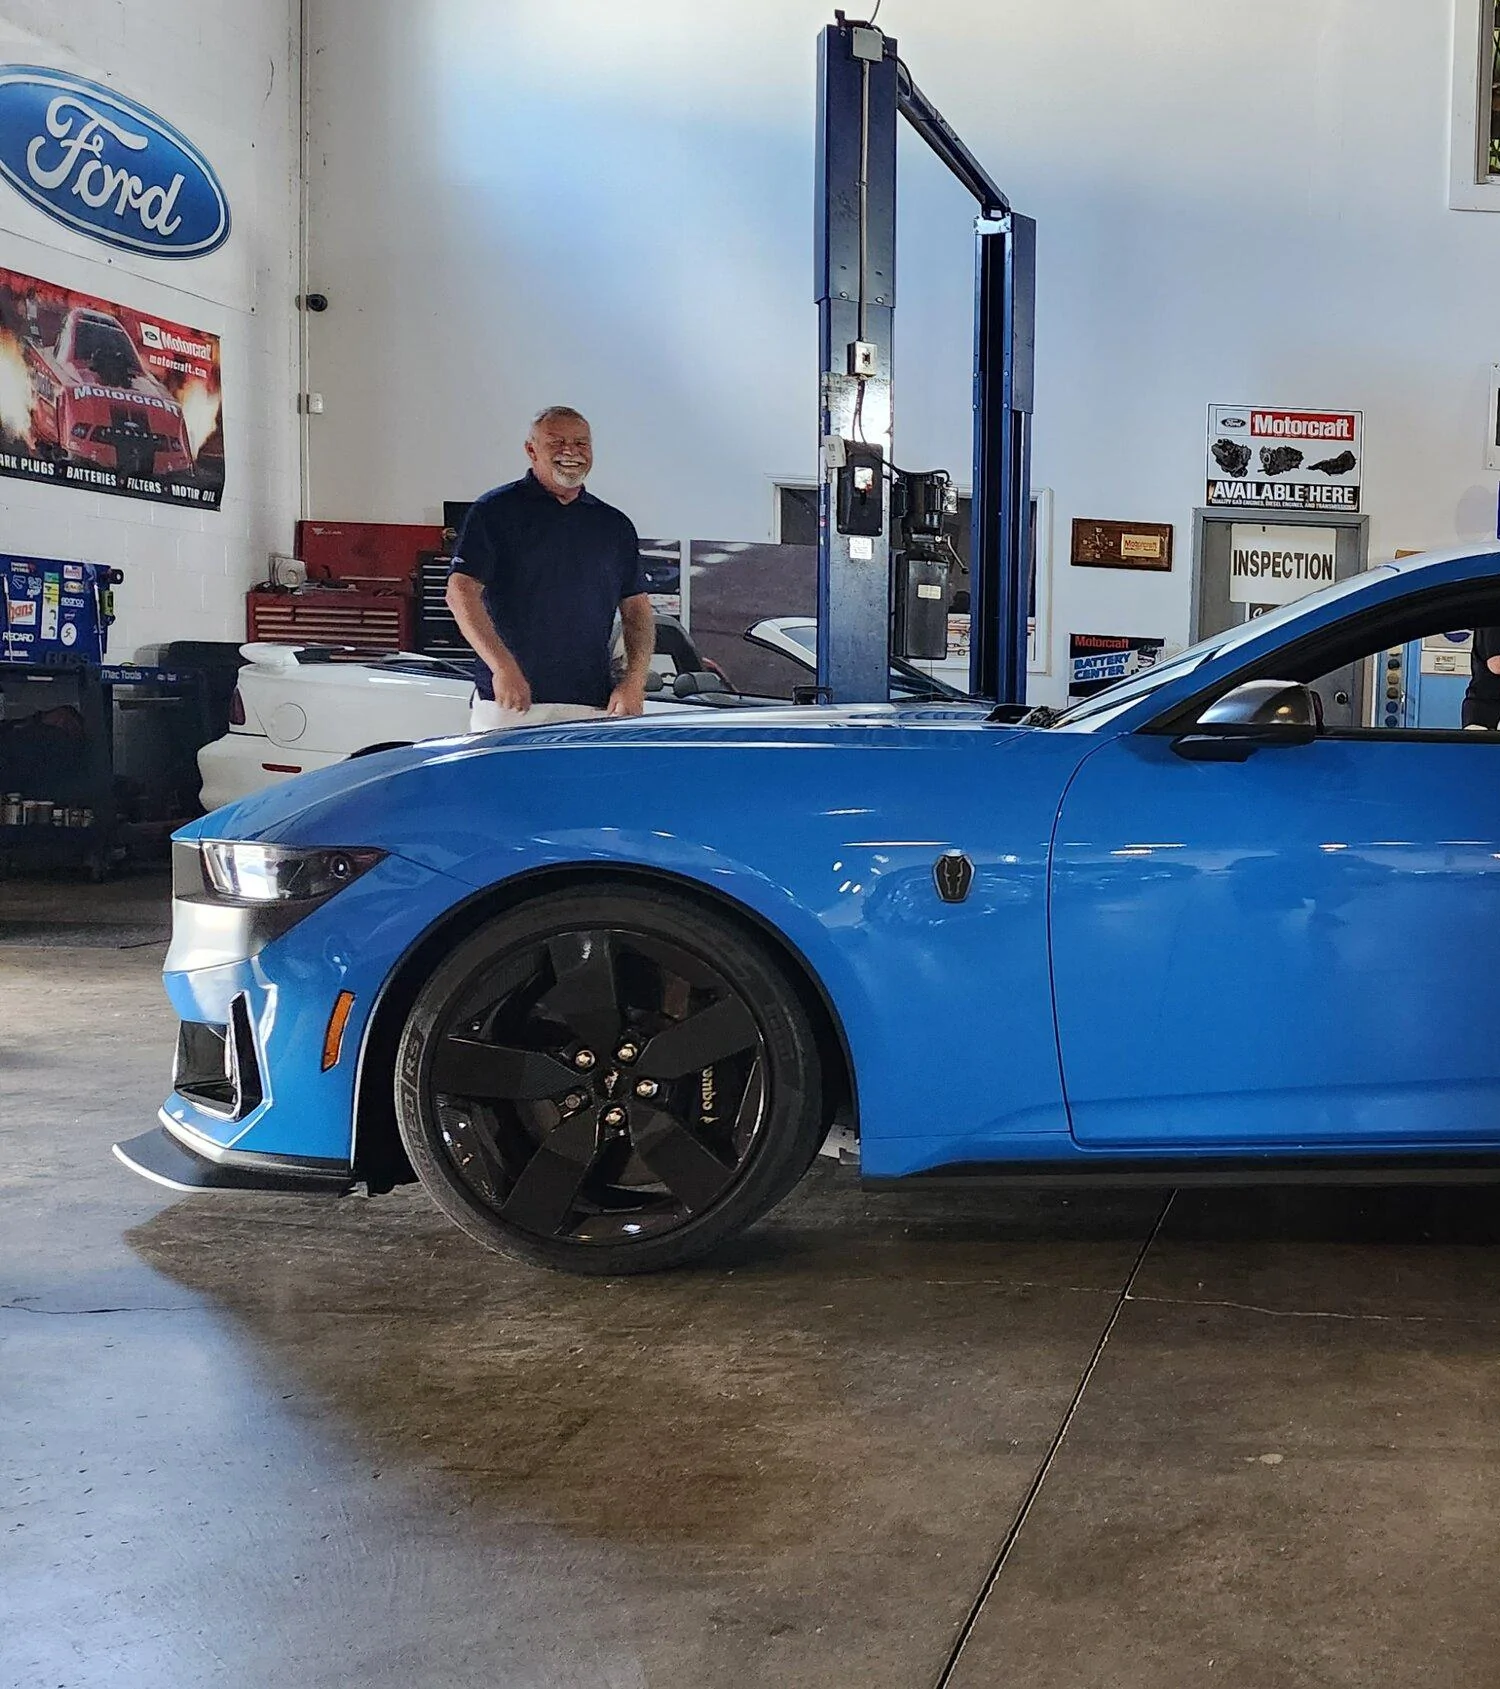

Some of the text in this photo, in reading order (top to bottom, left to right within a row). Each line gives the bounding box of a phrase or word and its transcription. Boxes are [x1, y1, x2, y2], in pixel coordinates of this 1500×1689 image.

[27, 96, 185, 236] Ford
[161, 331, 212, 361] Motorcraft
[149, 355, 207, 379] motorcraft.com
[73, 385, 181, 418] Motorcraft
[1254, 414, 1351, 438] Motorcraft
[21, 458, 55, 476] PLUGS
[67, 466, 117, 487] BATTERIES
[127, 477, 162, 494] FILTERS
[202, 491, 216, 503] OIL
[1213, 481, 1354, 504] AVAILABLE HERE
[1233, 550, 1333, 580] INSPECTION
[2, 632, 35, 643] RECARO
[1075, 636, 1129, 649] Motorcraft
[1074, 652, 1131, 670] BATTERY
[1074, 665, 1125, 680] CENTER
[101, 669, 142, 680] Mac Tools
